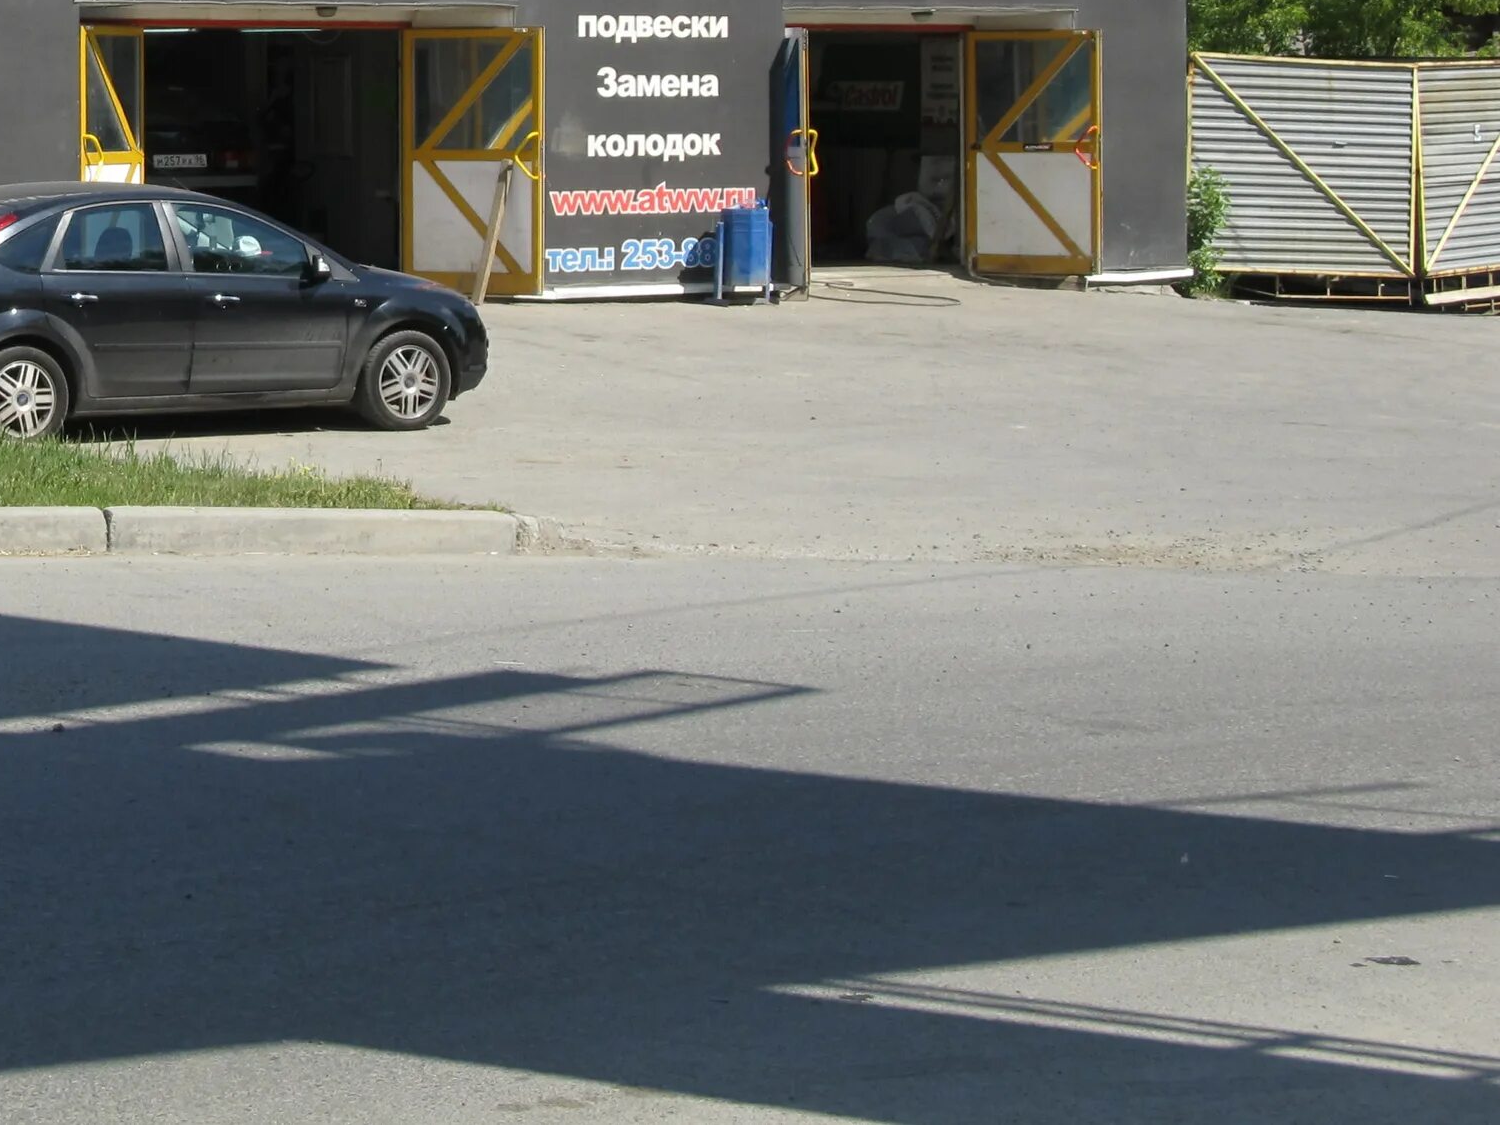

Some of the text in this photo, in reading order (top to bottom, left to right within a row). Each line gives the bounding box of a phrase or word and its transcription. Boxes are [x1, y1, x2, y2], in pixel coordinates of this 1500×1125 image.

[577, 12, 729, 41] подвески
[597, 67, 719, 98] Замена
[587, 129, 720, 158] колодок
[156, 155, 193, 167] М257
[549, 181, 757, 216] www.atww.ru
[545, 247, 615, 273] тел.:
